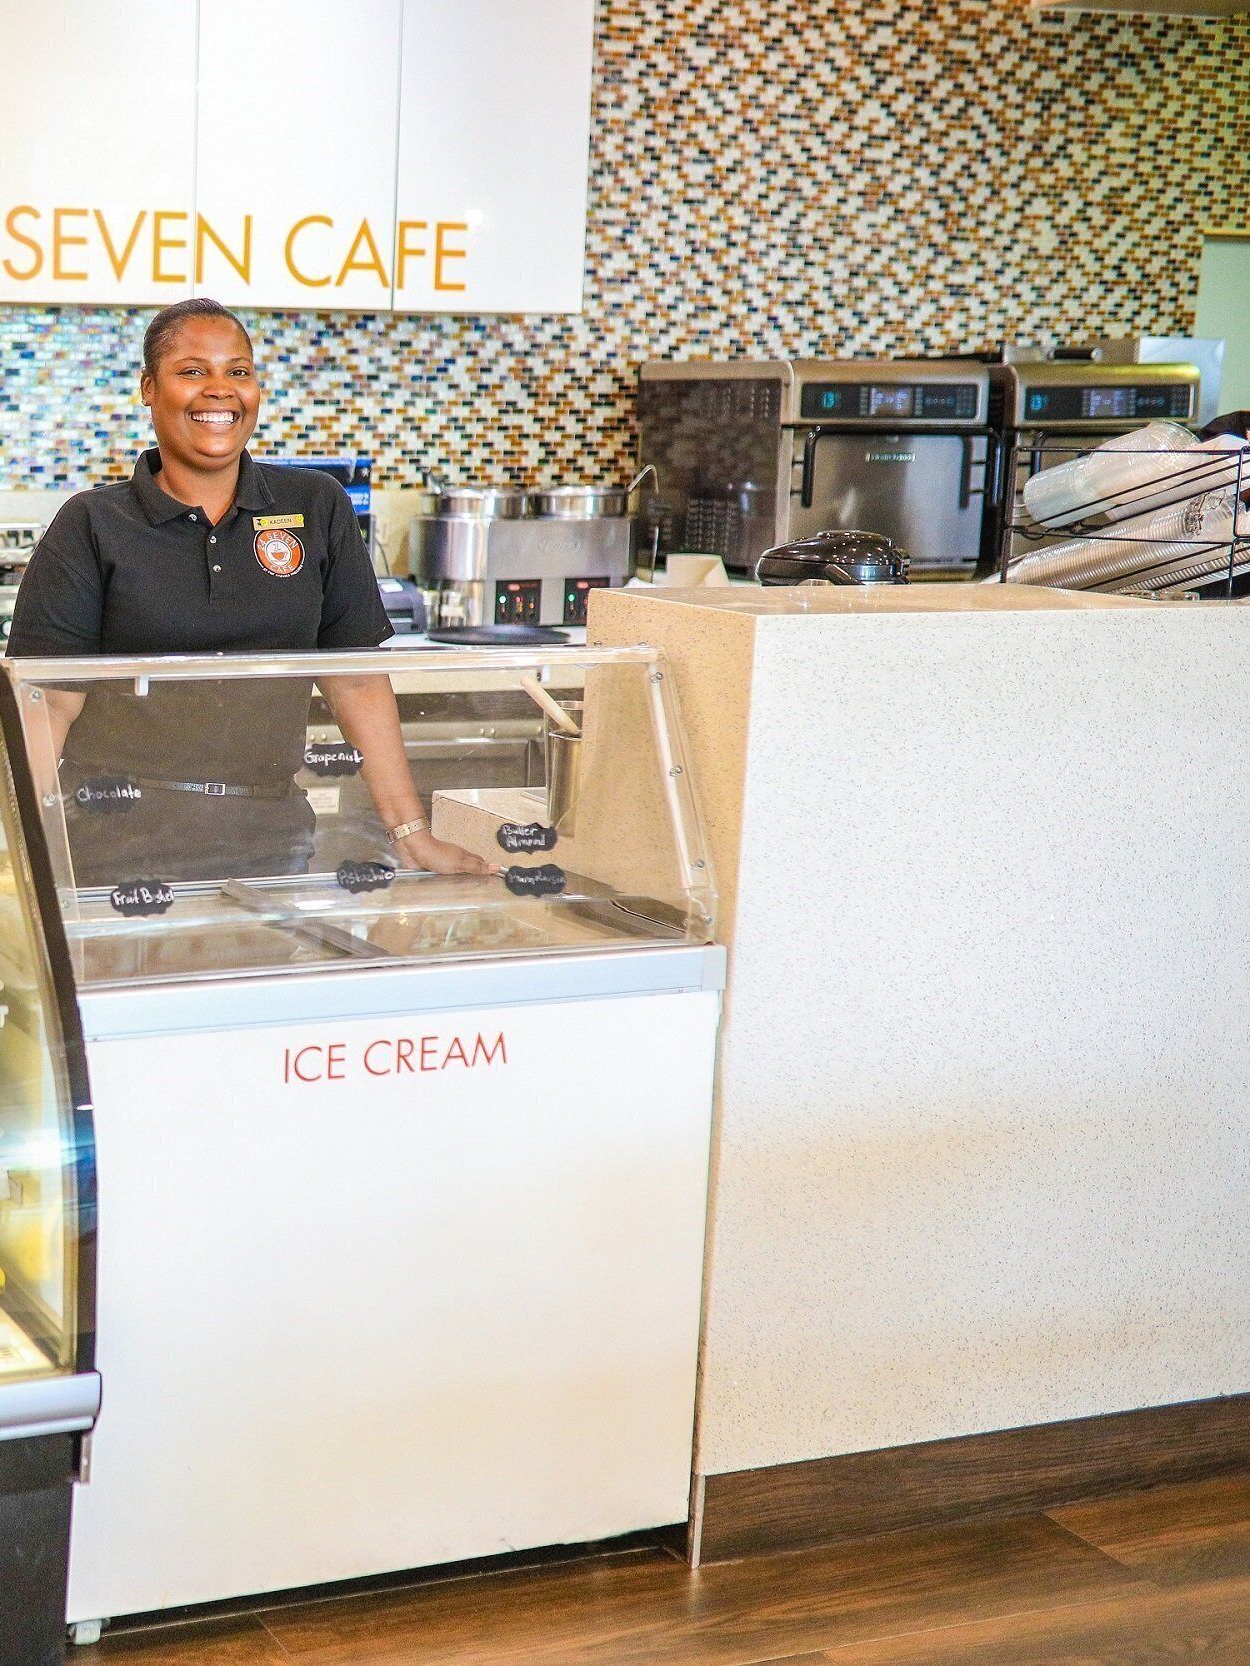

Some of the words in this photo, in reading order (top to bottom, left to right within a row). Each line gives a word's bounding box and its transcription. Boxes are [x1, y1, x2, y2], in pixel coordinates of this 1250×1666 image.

[2, 205, 252, 286] SEVEN
[284, 214, 469, 292] CAFE
[267, 532, 298, 548] SEVEN
[76, 783, 142, 802] Chocolate
[284, 1043, 347, 1084] ICE
[363, 1031, 508, 1076] CREAM
